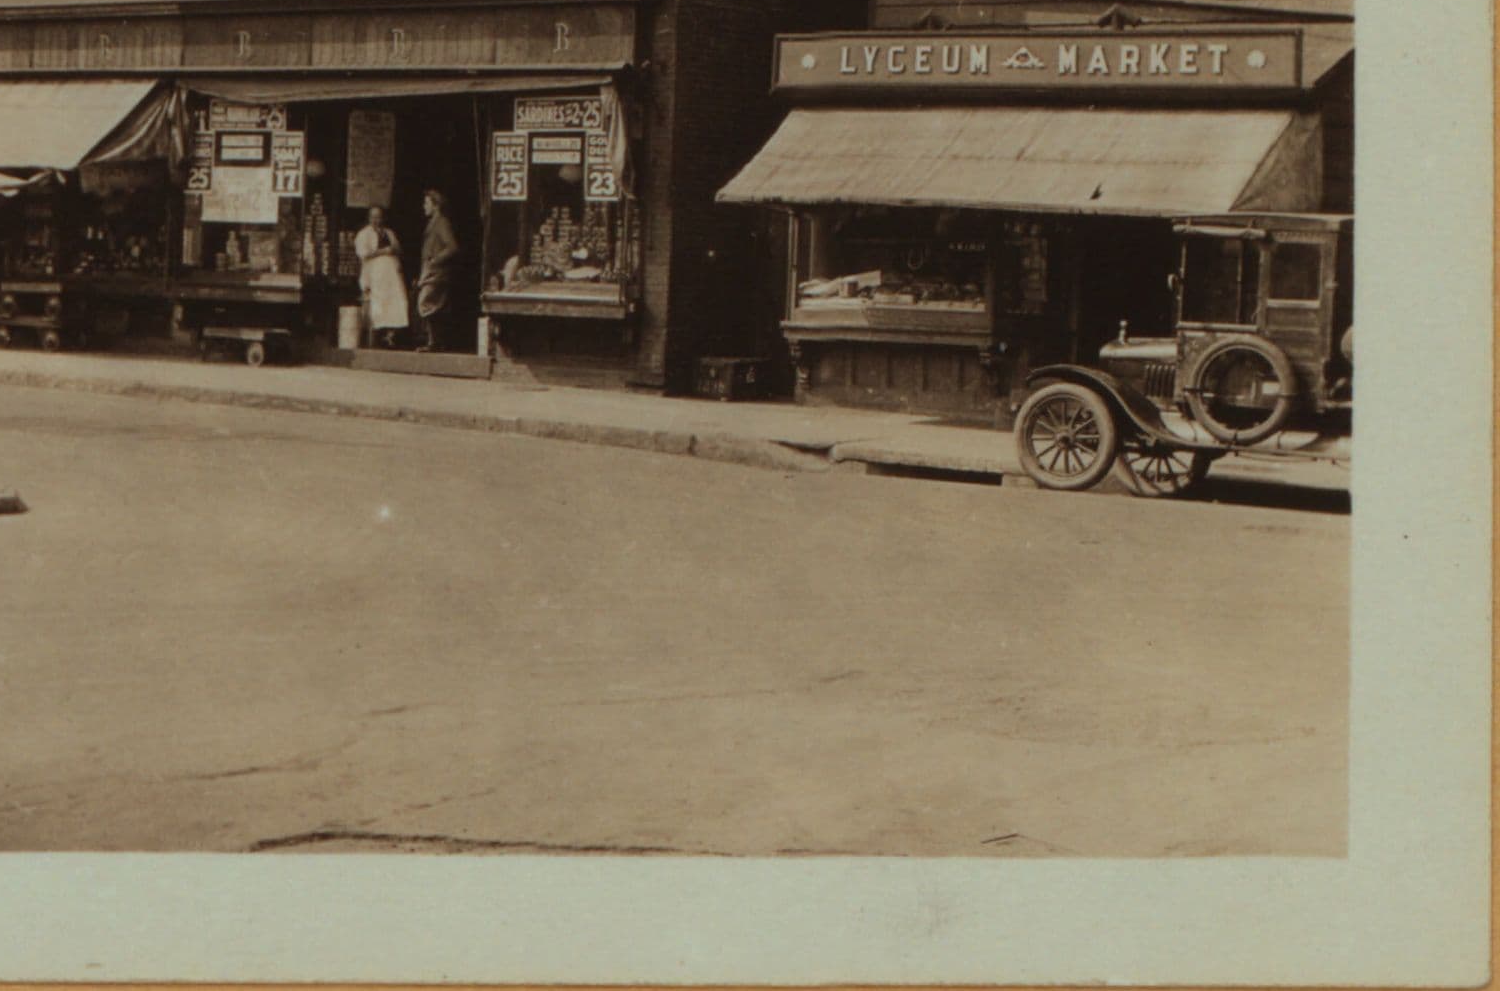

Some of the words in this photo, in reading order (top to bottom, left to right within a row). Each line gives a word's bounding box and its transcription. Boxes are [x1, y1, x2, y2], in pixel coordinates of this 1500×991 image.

[553, 22, 571, 53] B
[840, 44, 990, 75] LYCEUM
[1057, 43, 1229, 76] MARKET
[496, 145, 524, 162] RICE
[187, 168, 210, 189] 25
[274, 169, 299, 192] 17
[497, 172, 524, 194] 25
[590, 171, 615, 195] 23
